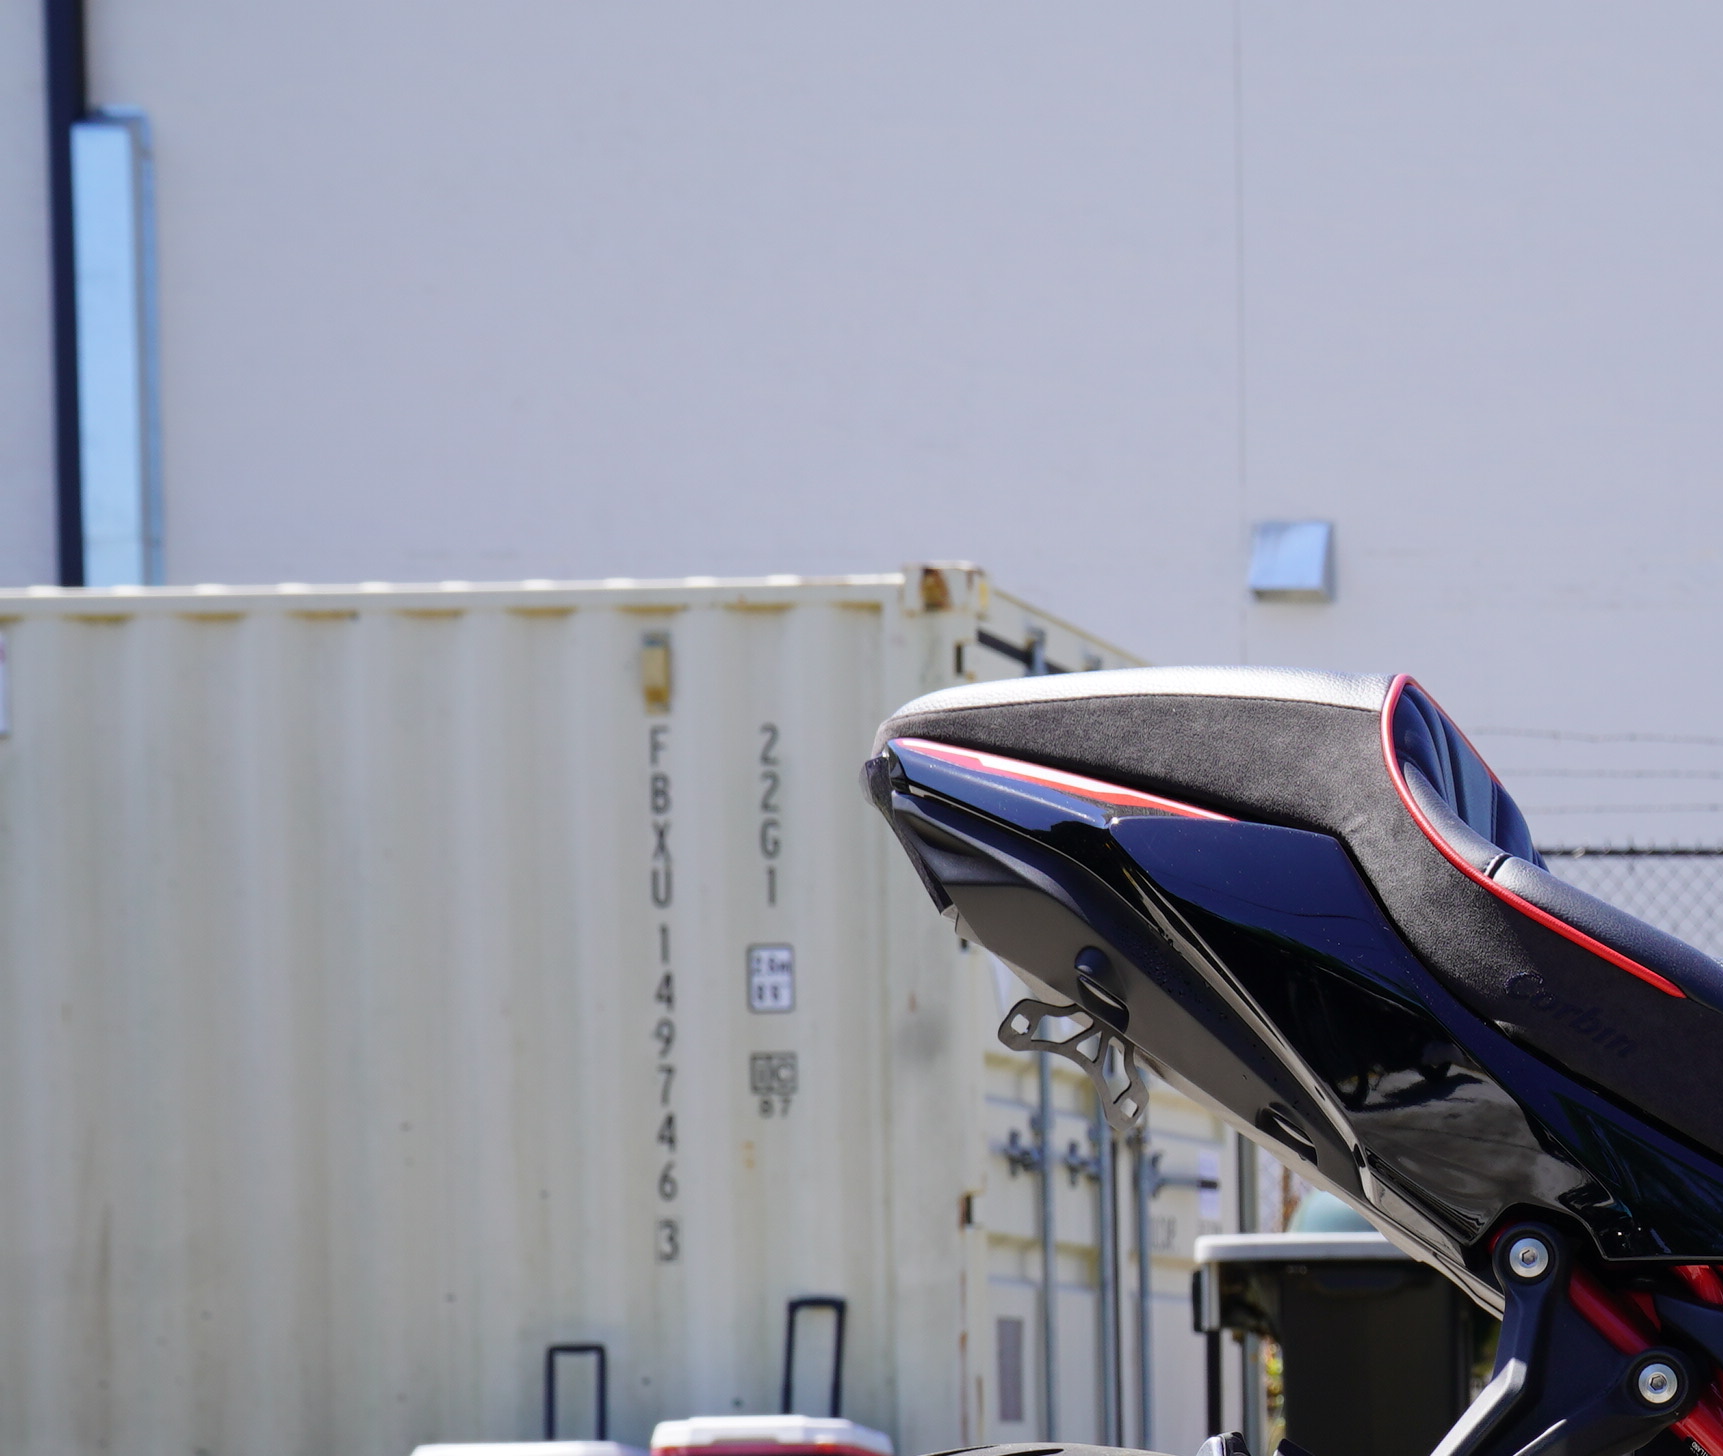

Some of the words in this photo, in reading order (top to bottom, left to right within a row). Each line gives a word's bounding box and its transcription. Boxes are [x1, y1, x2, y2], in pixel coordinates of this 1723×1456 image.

[648, 726, 673, 907] FBXU
[758, 724, 781, 906] 22G1
[652, 925, 679, 1200] 149746
[1503, 972, 1640, 1059] Corbin
